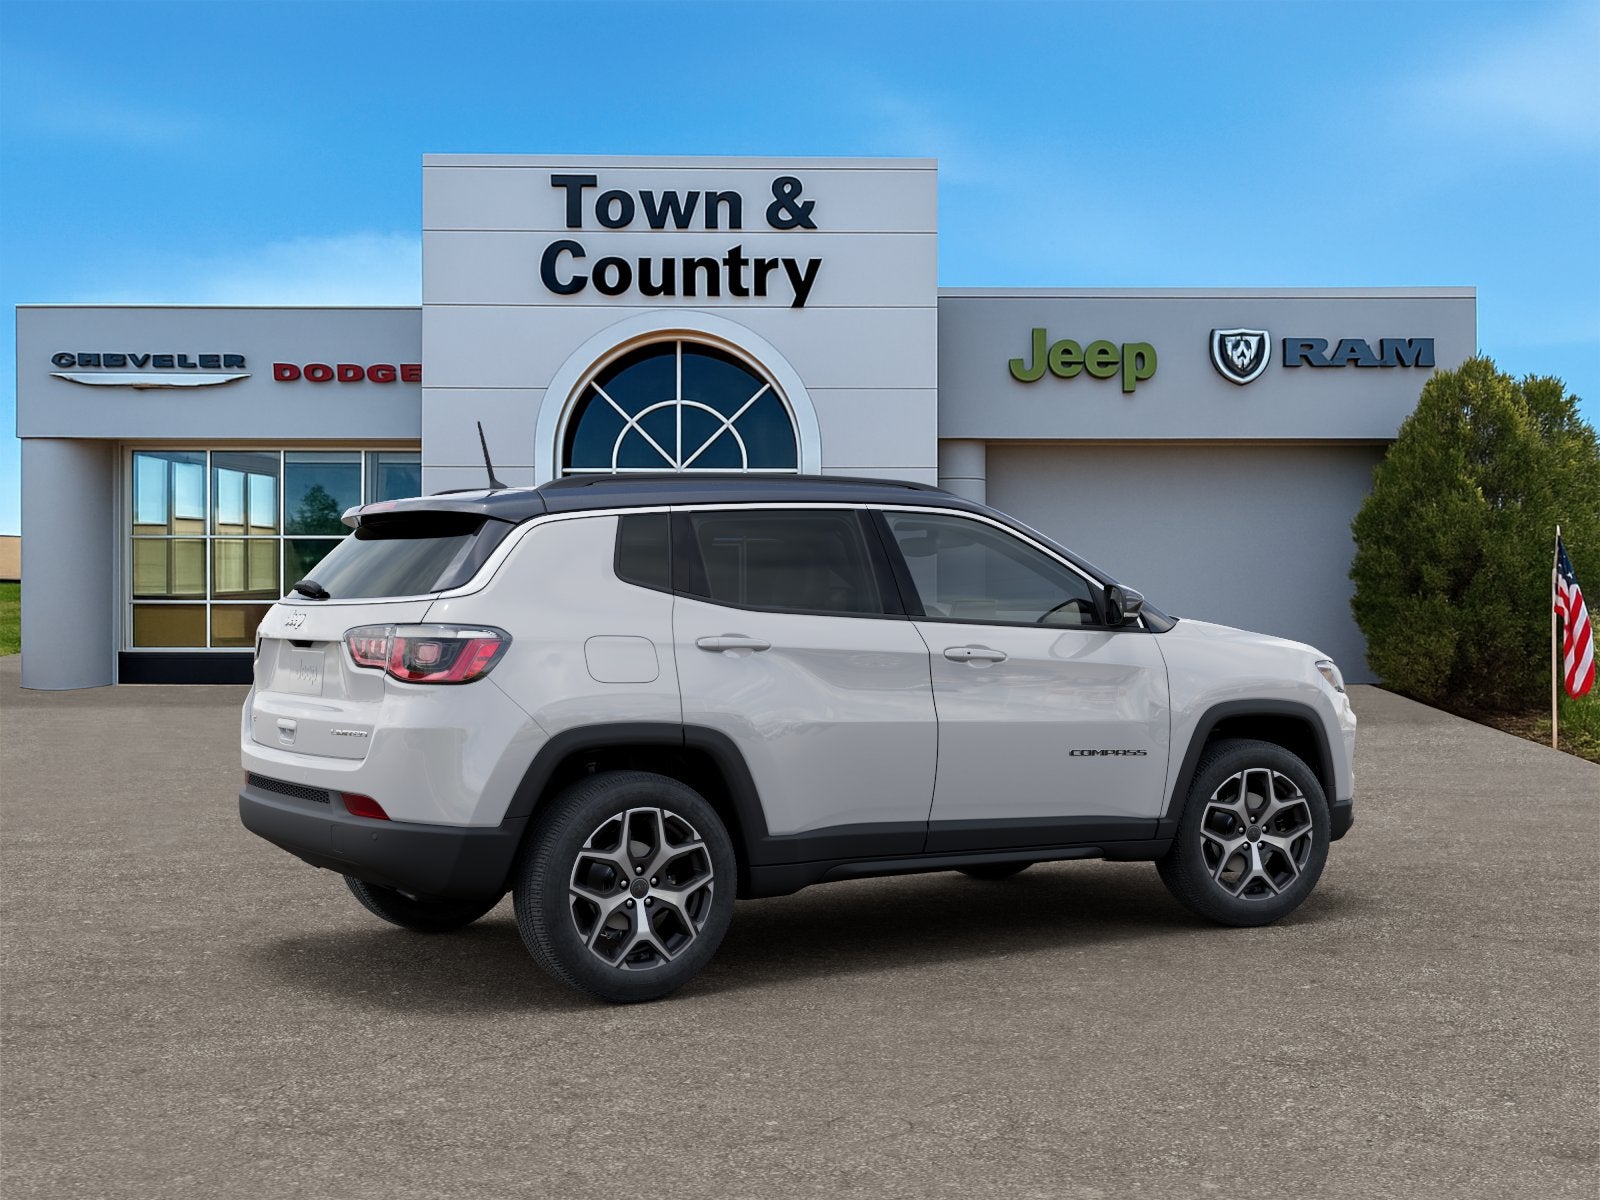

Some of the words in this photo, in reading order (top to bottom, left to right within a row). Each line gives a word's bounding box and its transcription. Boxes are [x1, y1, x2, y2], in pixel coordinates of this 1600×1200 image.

[550, 174, 743, 229] Town
[765, 175, 818, 230] &
[539, 239, 822, 308] Country
[272, 362, 422, 383] DODGE
[1008, 327, 1157, 393] Jeep
[1282, 337, 1436, 368] RAM
[1069, 749, 1148, 757] COMPASS
